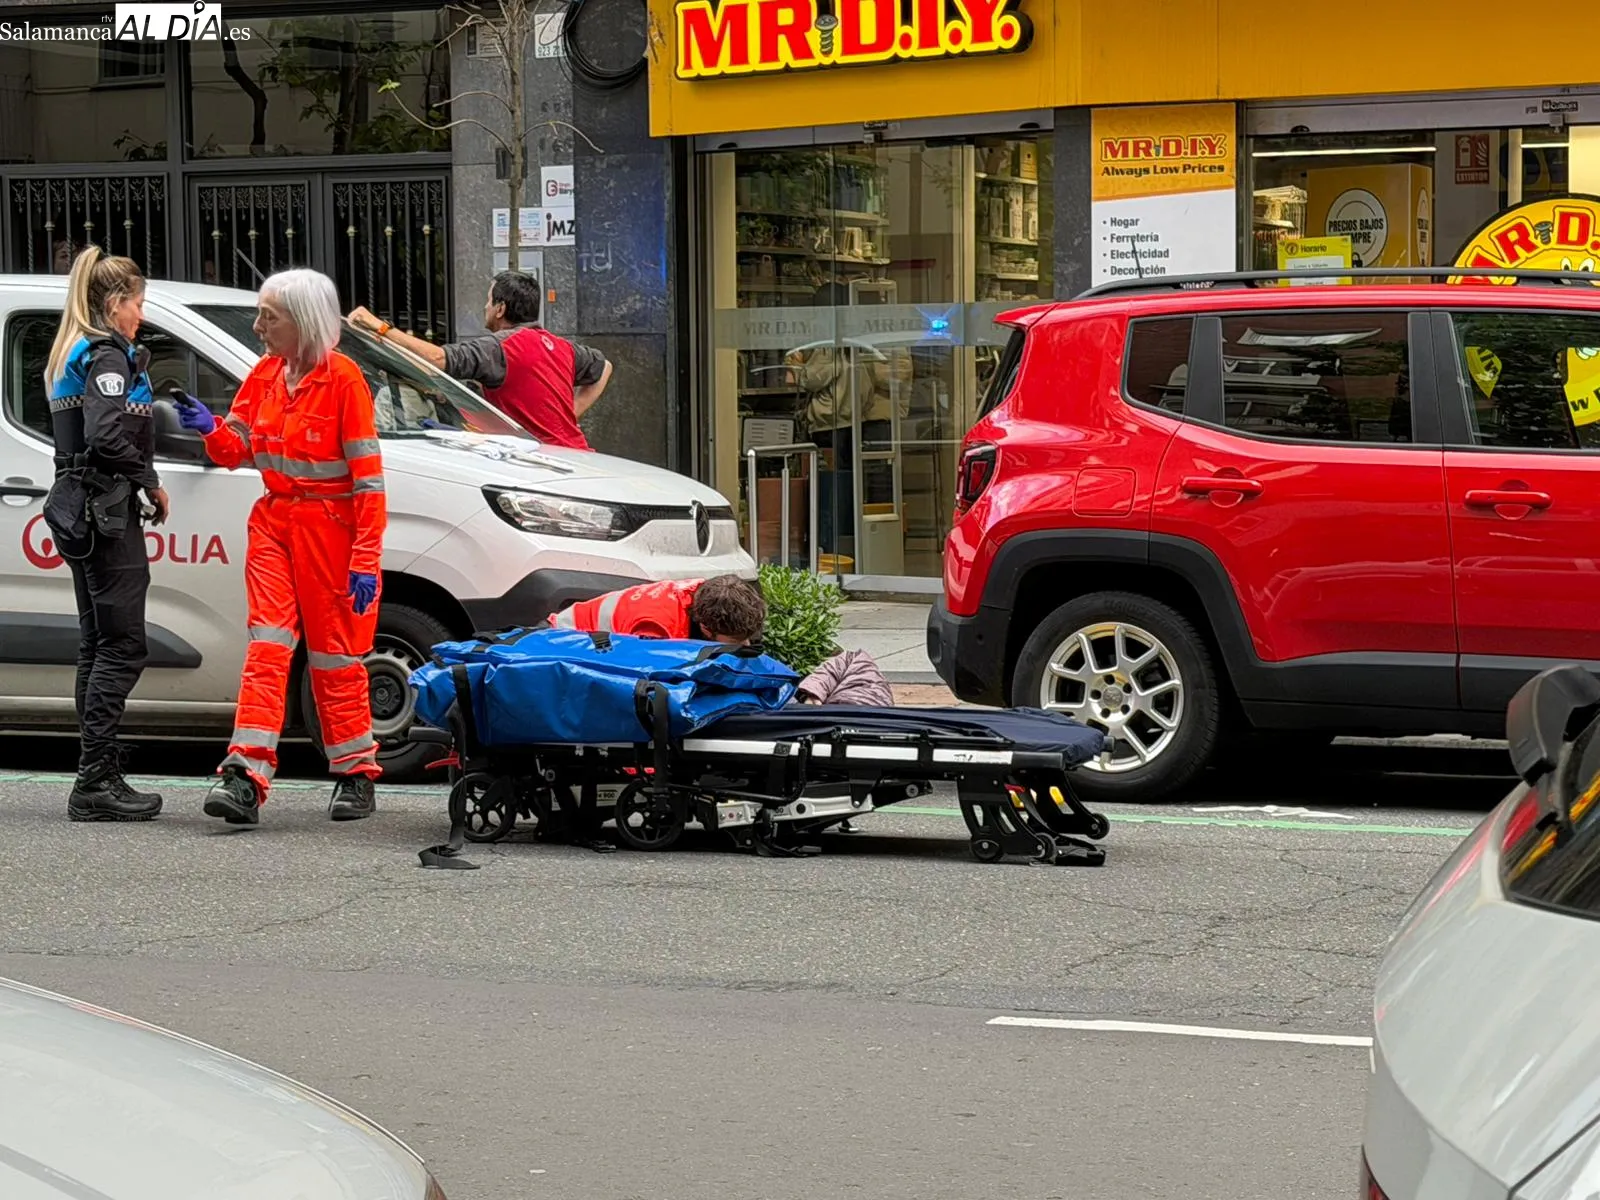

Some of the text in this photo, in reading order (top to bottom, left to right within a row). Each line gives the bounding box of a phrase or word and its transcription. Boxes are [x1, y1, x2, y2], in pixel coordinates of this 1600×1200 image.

[1101, 163, 1225, 178] Always Low Prices
[1110, 217, 1140, 228] Hogar
[1328, 218, 1384, 233] PRECIOS BAJOS
[1110, 232, 1160, 243] Ferretería
[1110, 248, 1170, 259] Electricidad
[1110, 265, 1166, 276] Decoración
[145, 532, 230, 565] OLIA
